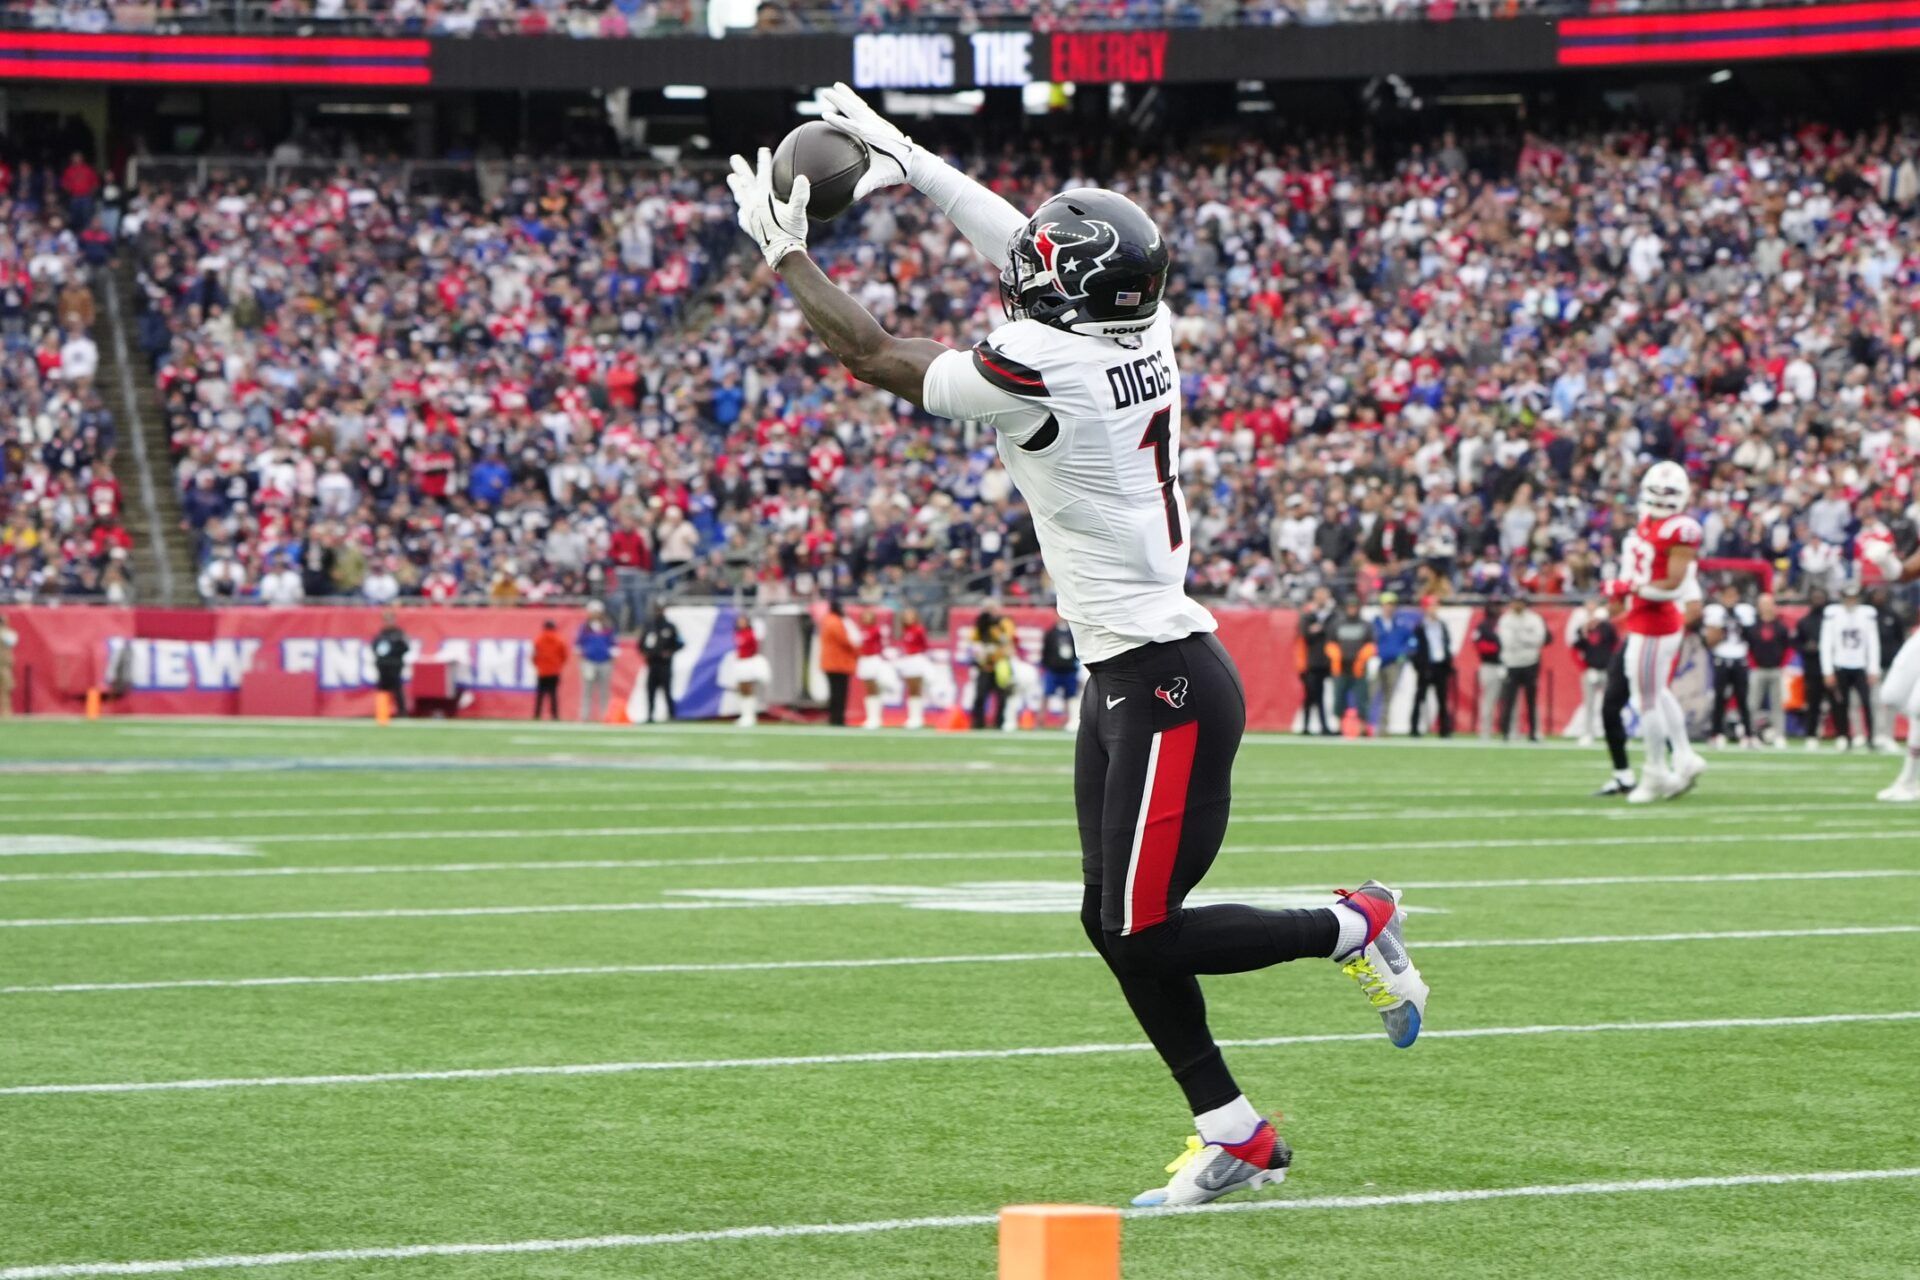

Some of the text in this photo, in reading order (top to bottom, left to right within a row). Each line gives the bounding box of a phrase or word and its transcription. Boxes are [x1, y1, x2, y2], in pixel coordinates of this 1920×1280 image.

[854, 31, 1167, 87] BRING THE ENERGY
[1106, 350, 1172, 410] DIGGS
[1137, 404, 1184, 552] 1
[106, 636, 261, 692] NEW
